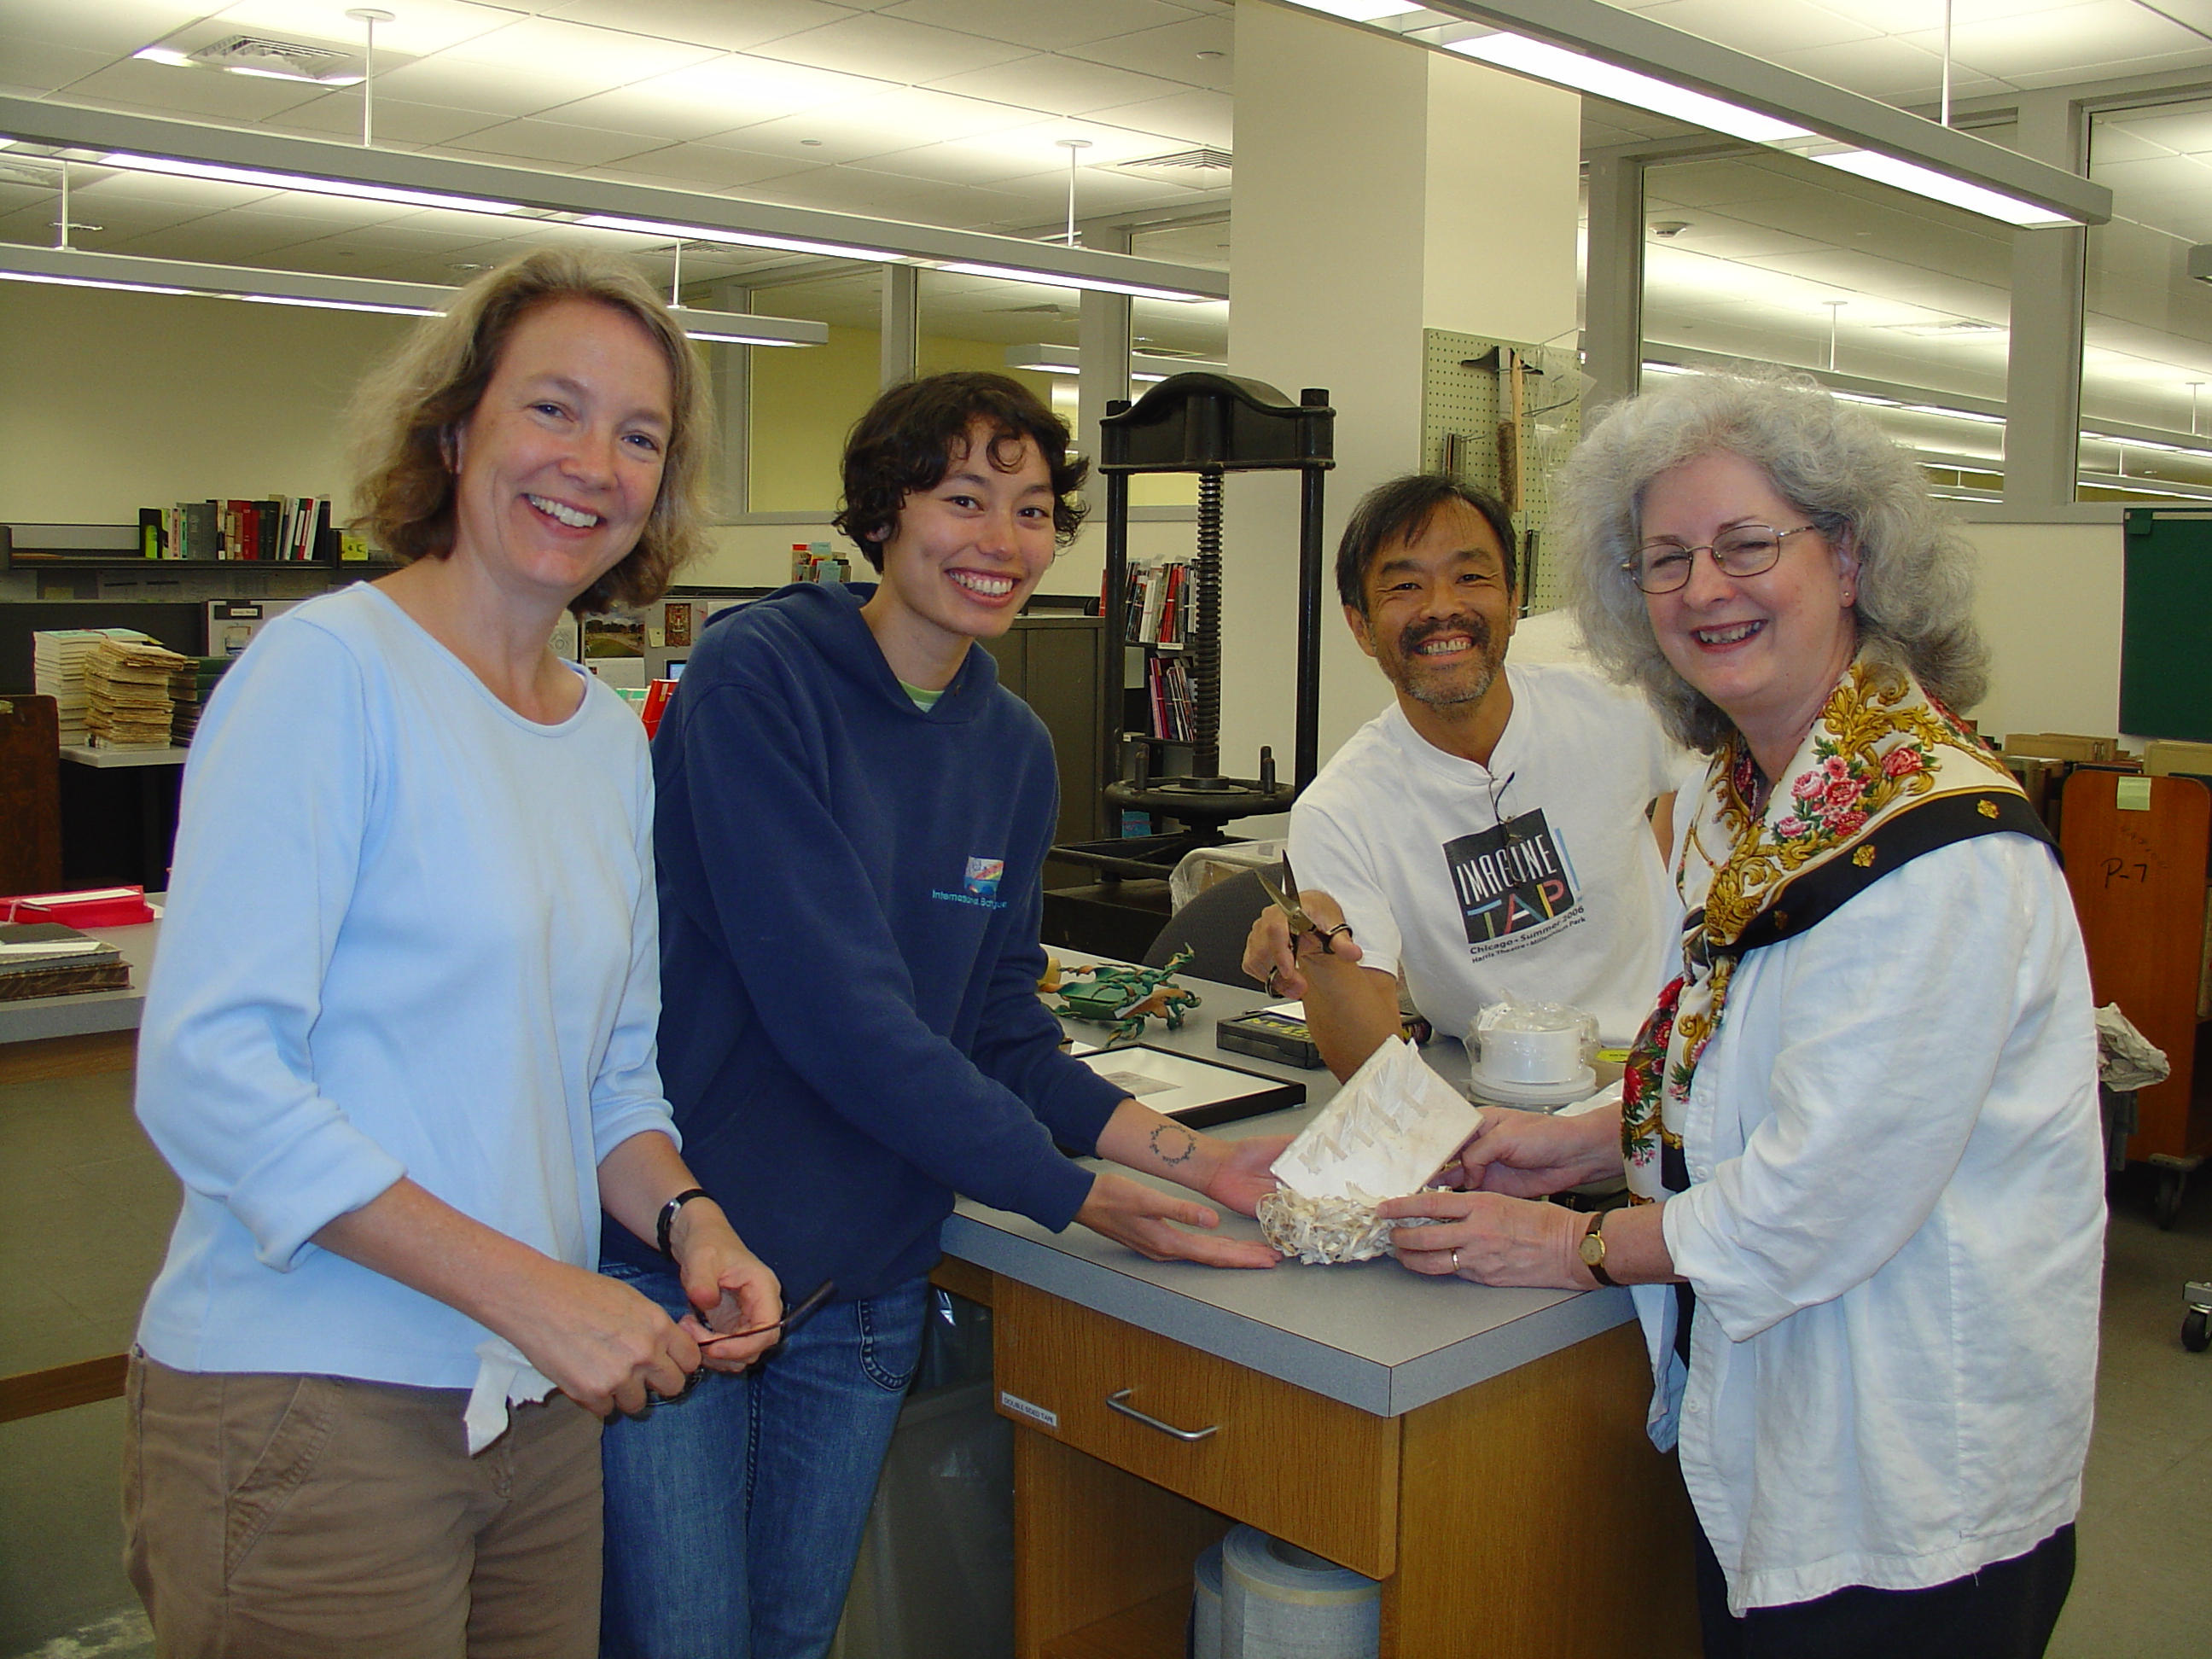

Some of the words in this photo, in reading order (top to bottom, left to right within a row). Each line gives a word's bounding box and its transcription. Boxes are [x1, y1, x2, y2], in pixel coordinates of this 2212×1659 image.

[1456, 834, 1557, 905] IMAGINE
[2100, 857, 2148, 889] P-7
[1466, 879, 1565, 940] TAP
[1470, 939, 1513, 955] Chicago
[1520, 921, 1561, 942] Summer
[1562, 905, 1585, 923] 2006
[1471, 952, 1495, 964] Harris
[1569, 916, 1586, 928] Park
